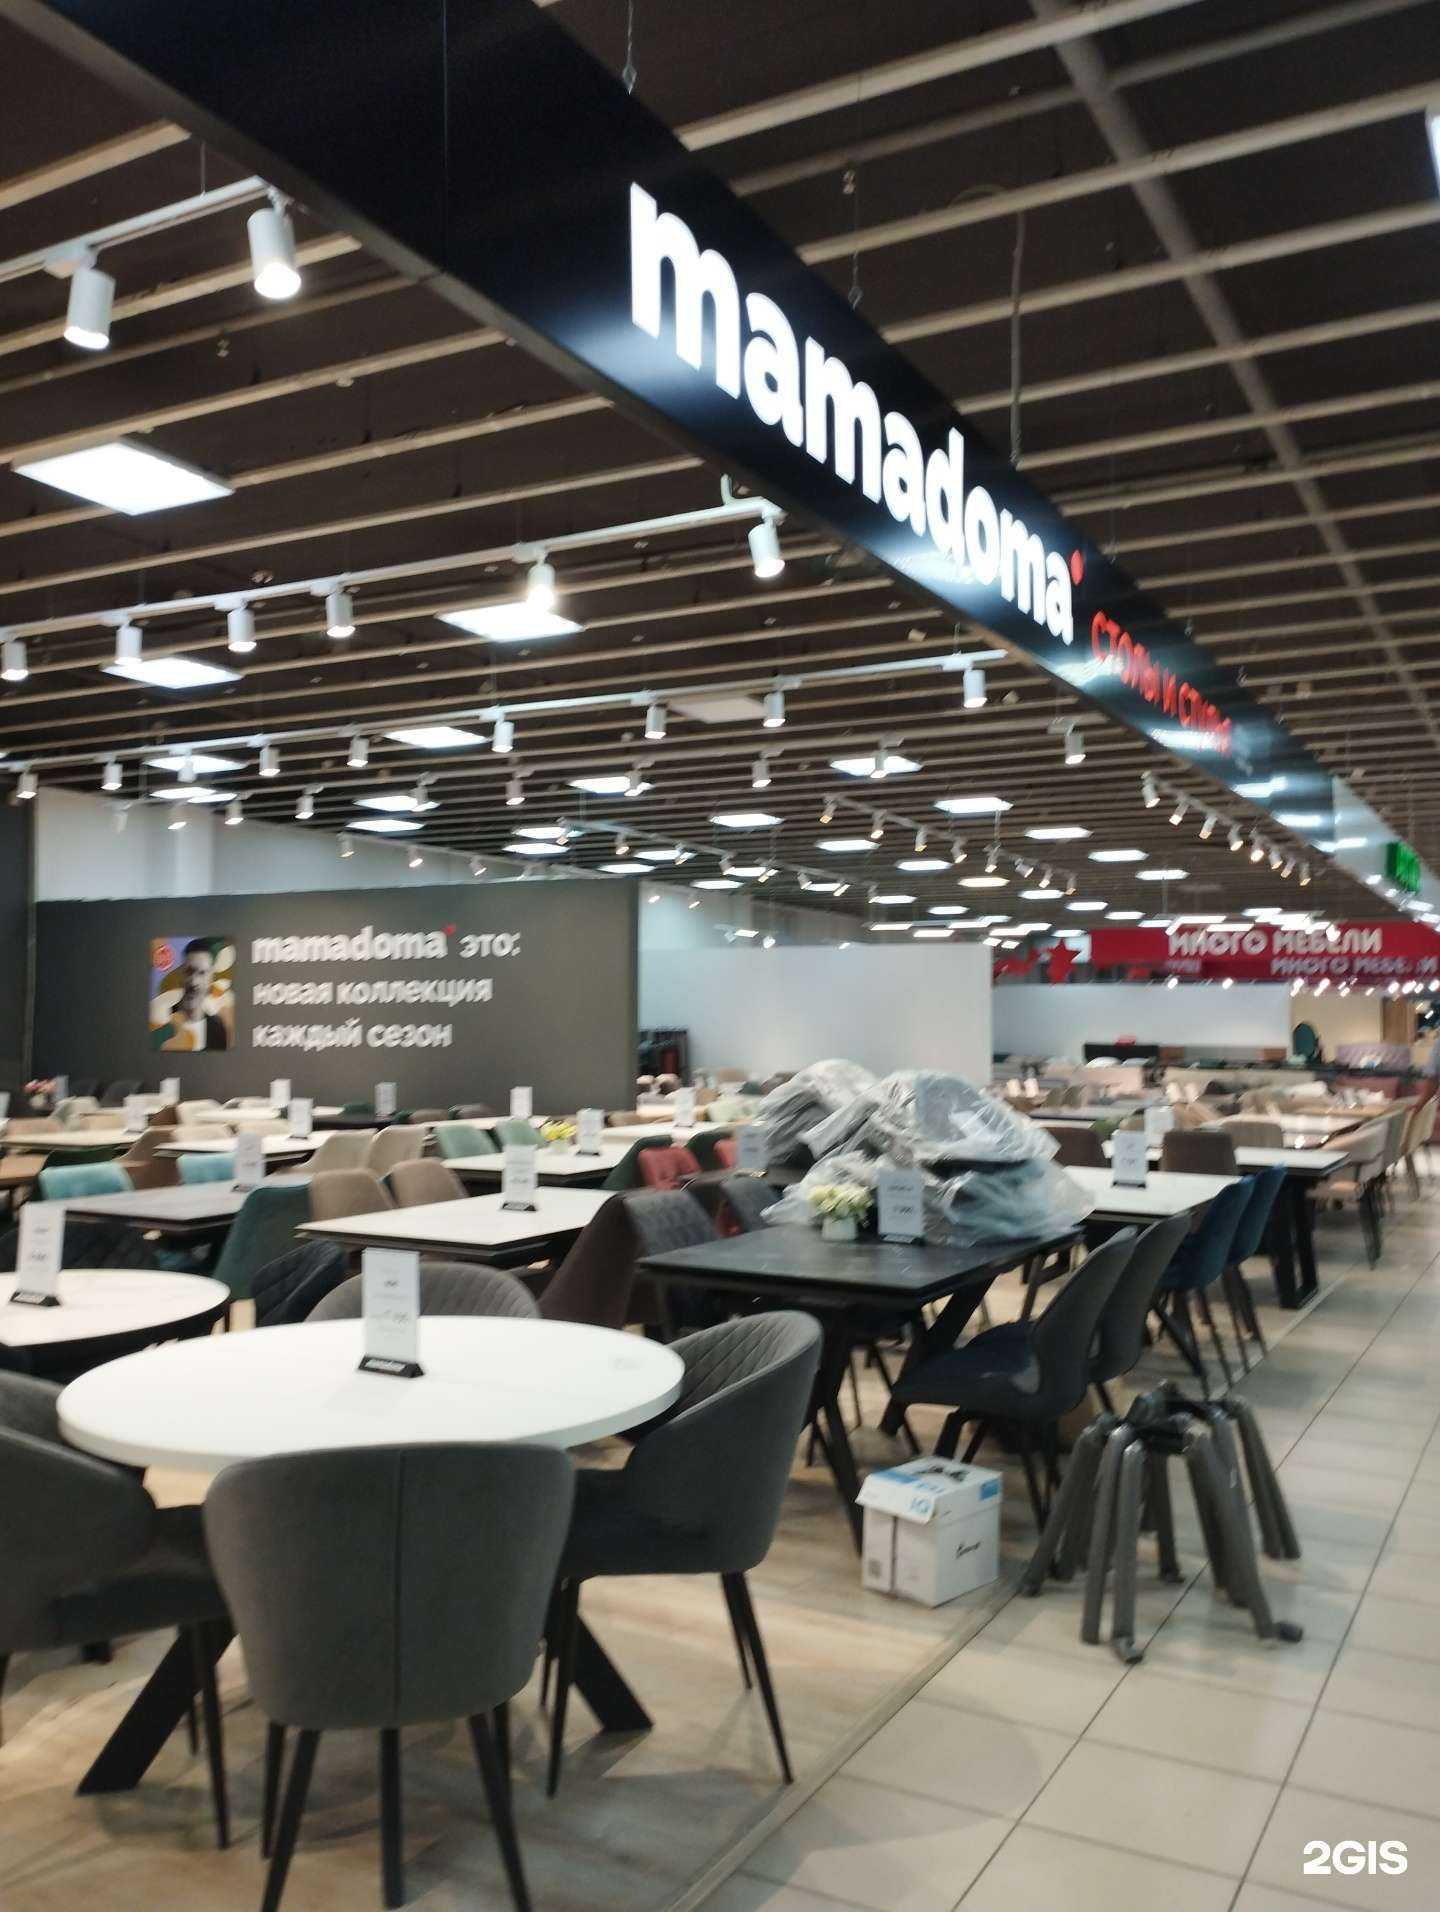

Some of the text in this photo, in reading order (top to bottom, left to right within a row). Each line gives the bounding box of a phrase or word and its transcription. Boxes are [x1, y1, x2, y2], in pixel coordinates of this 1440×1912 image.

[630, 181, 1074, 646] mamadoma
[251, 925, 449, 963] mamadoma
[252, 978, 494, 1007] новая коллекция
[252, 1017, 453, 1051] каждый сезон
